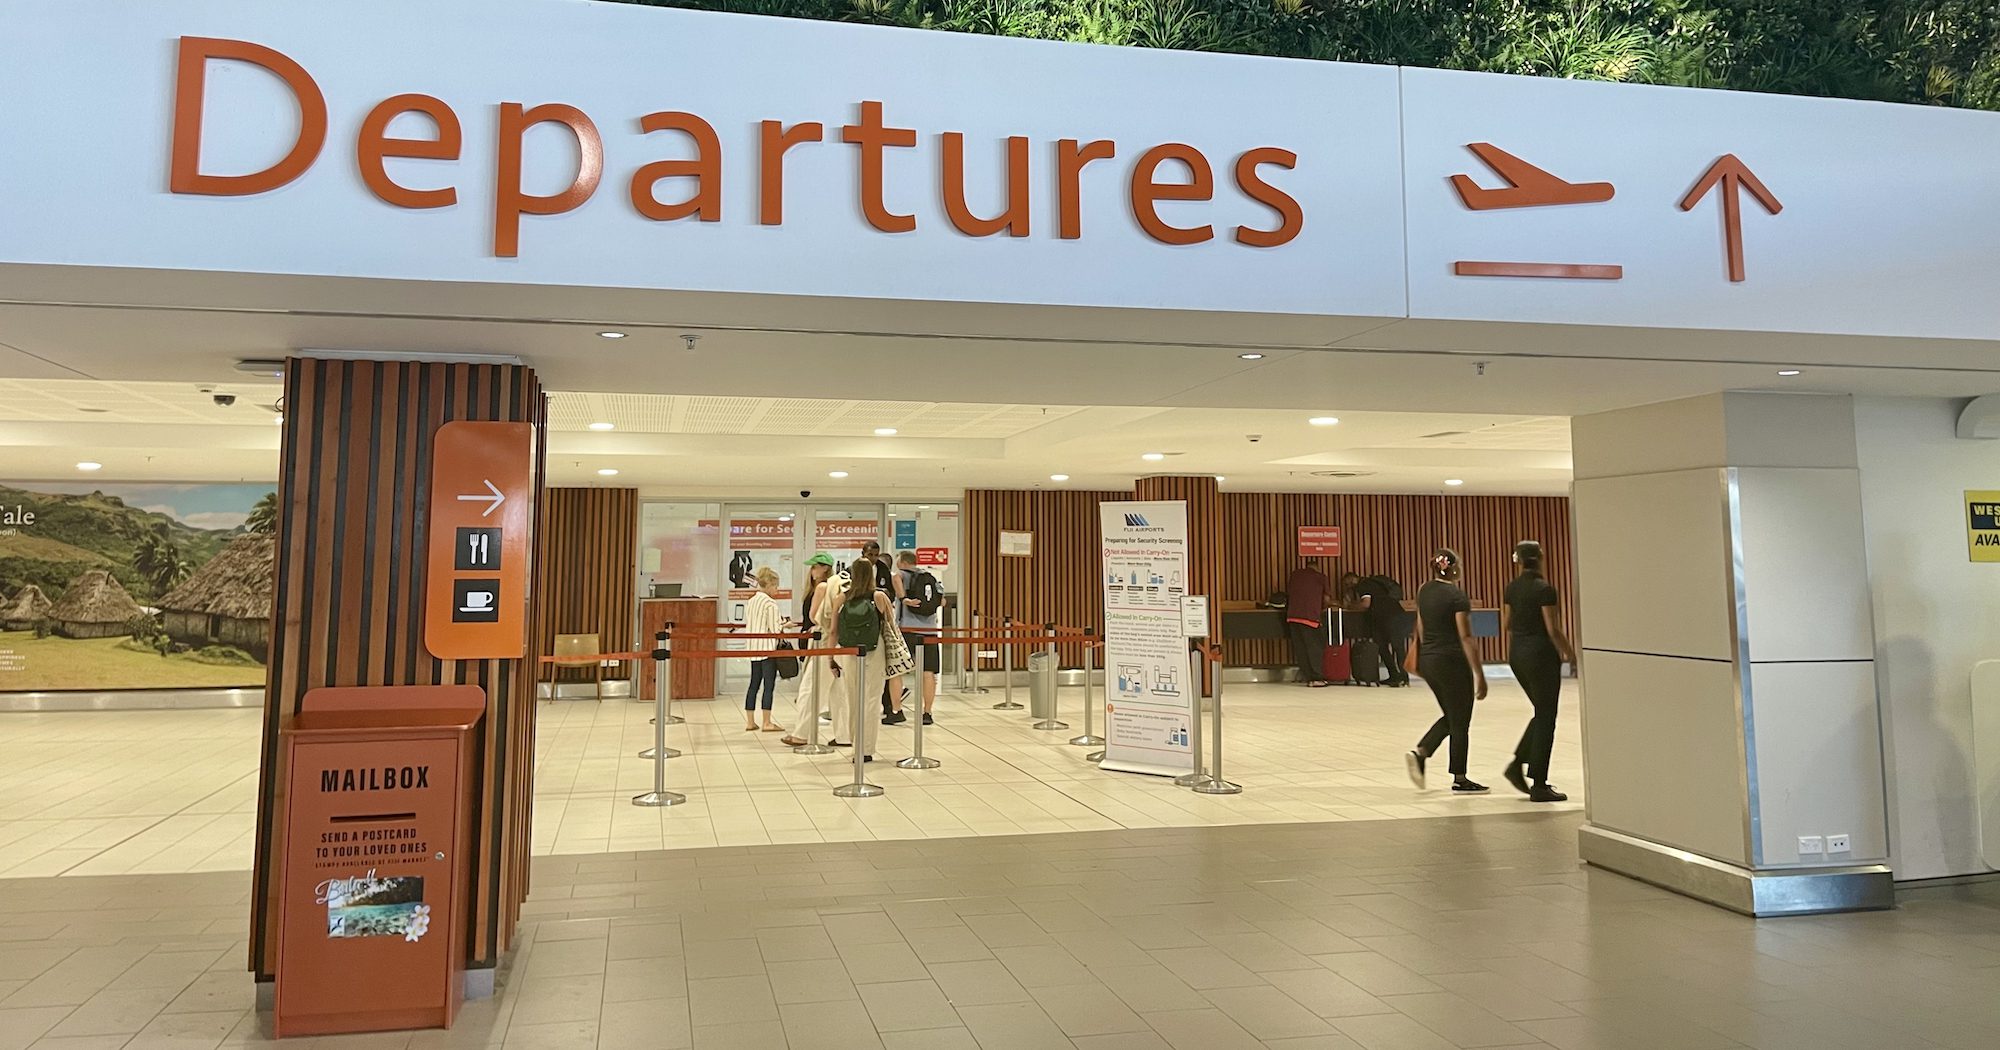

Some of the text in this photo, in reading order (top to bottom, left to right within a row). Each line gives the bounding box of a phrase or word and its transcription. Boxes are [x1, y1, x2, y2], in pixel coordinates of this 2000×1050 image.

[170, 35, 1304, 258] Departures
[729, 525, 752, 534] are
[756, 524, 773, 534] for
[1105, 537, 1128, 545] Preparing
[321, 766, 429, 792] MAILBOX
[321, 828, 417, 843] SEND A POSTCARD
[316, 842, 427, 858] TO YOUR LOVED ONES
